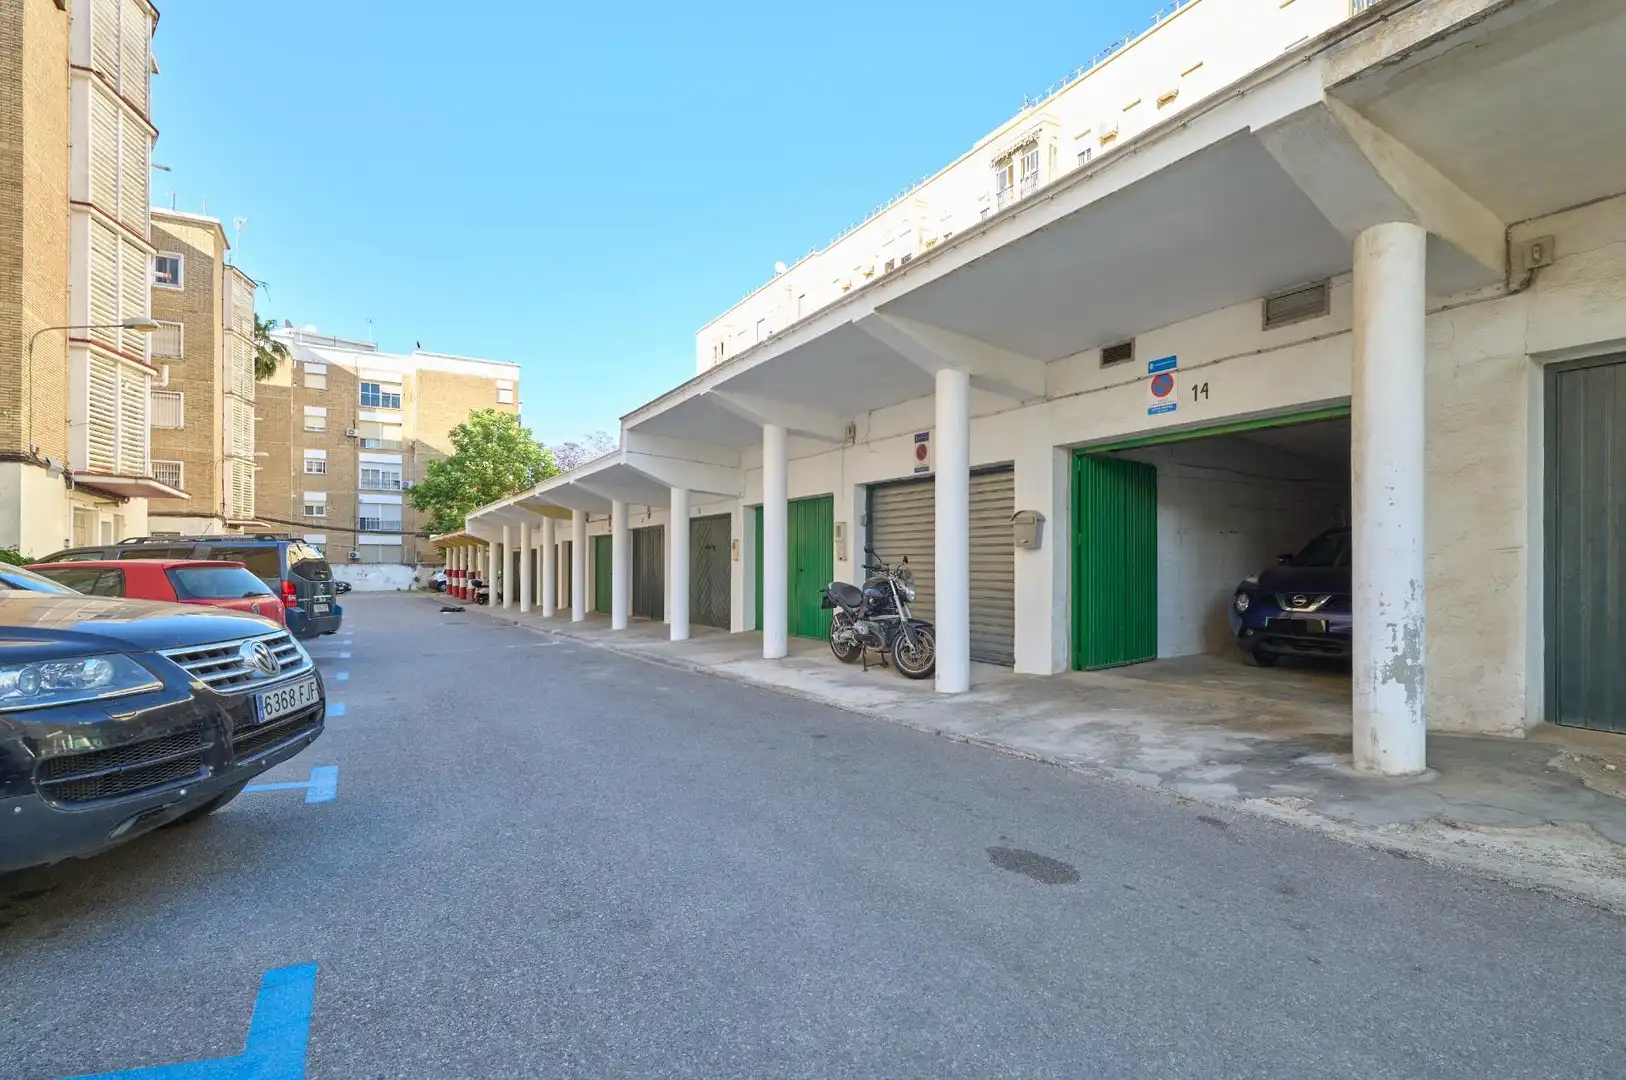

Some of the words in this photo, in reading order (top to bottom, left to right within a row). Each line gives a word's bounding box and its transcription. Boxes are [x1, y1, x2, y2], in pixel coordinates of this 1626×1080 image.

[1192, 382, 1209, 402] 14
[264, 688, 296, 715] 6368
[299, 681, 315, 704] FJF
